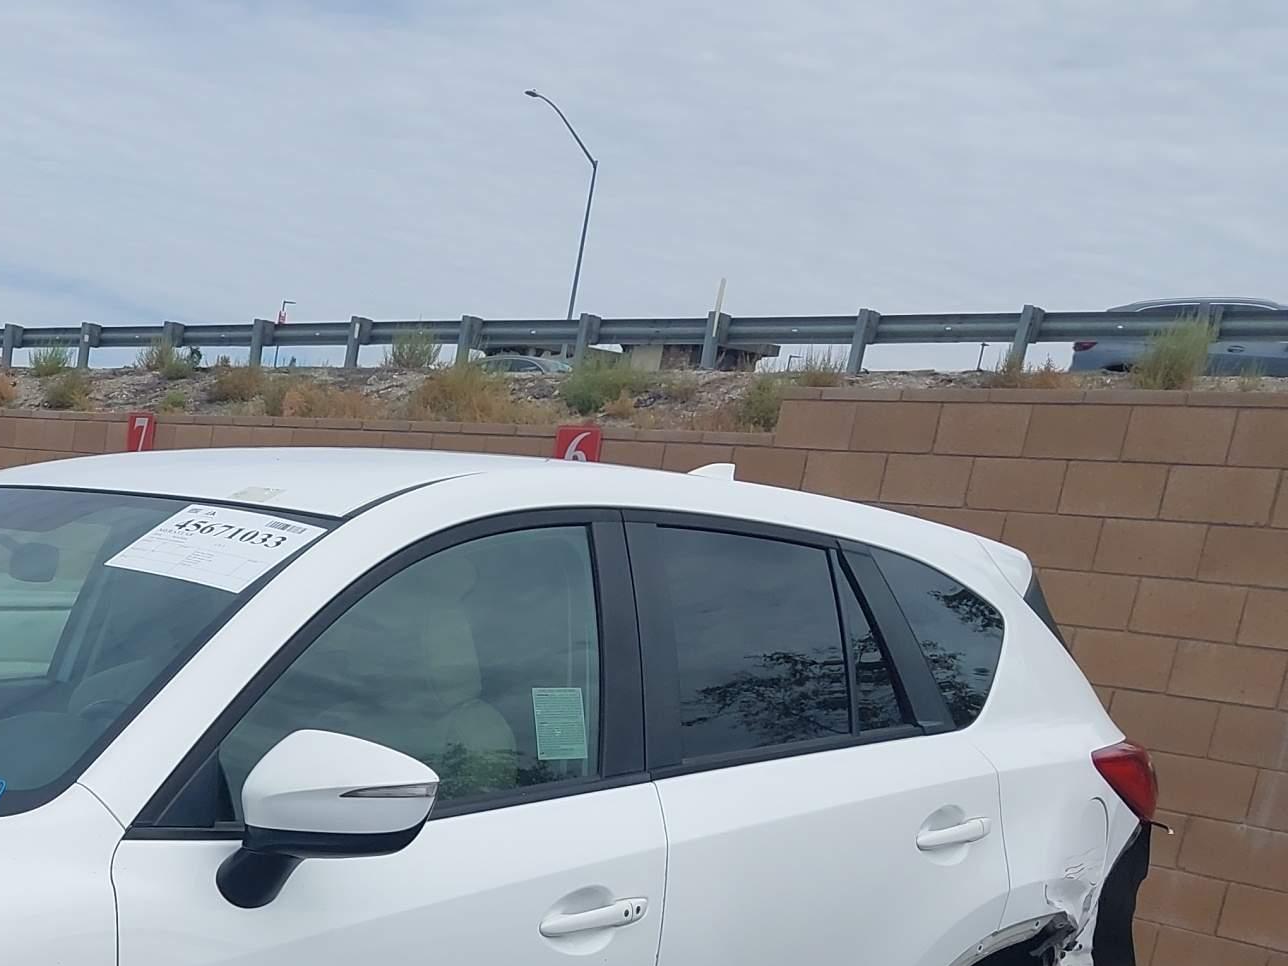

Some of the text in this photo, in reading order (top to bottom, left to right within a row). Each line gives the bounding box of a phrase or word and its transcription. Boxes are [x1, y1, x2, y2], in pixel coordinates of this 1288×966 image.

[133, 417, 149, 452] 7
[564, 431, 591, 462] 6
[175, 518, 288, 549] 45671033
